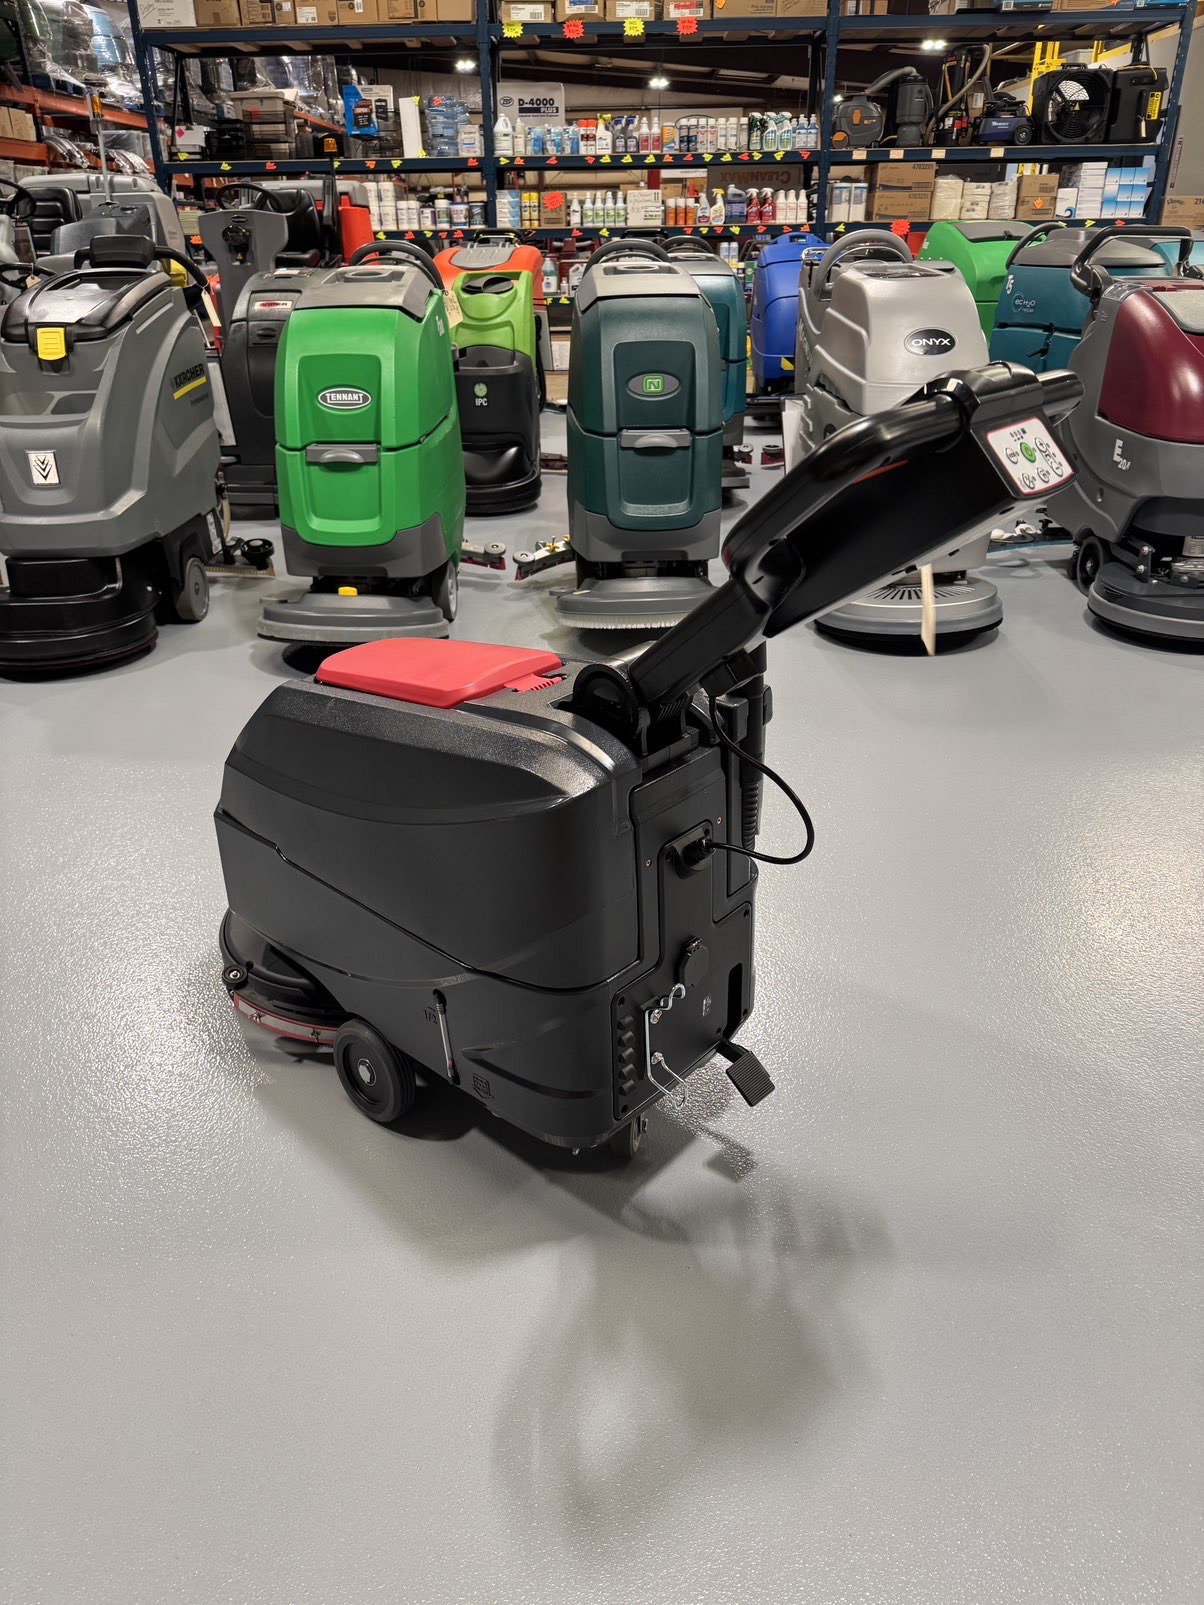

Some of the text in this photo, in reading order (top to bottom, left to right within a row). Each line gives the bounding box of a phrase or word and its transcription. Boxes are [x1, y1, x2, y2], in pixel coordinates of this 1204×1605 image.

[518, 98, 555, 107] D-4000
[911, 338, 951, 346] ONYX
[325, 393, 364, 403] TENNANT
[475, 397, 488, 406] IPC
[1112, 438, 1124, 463] E
